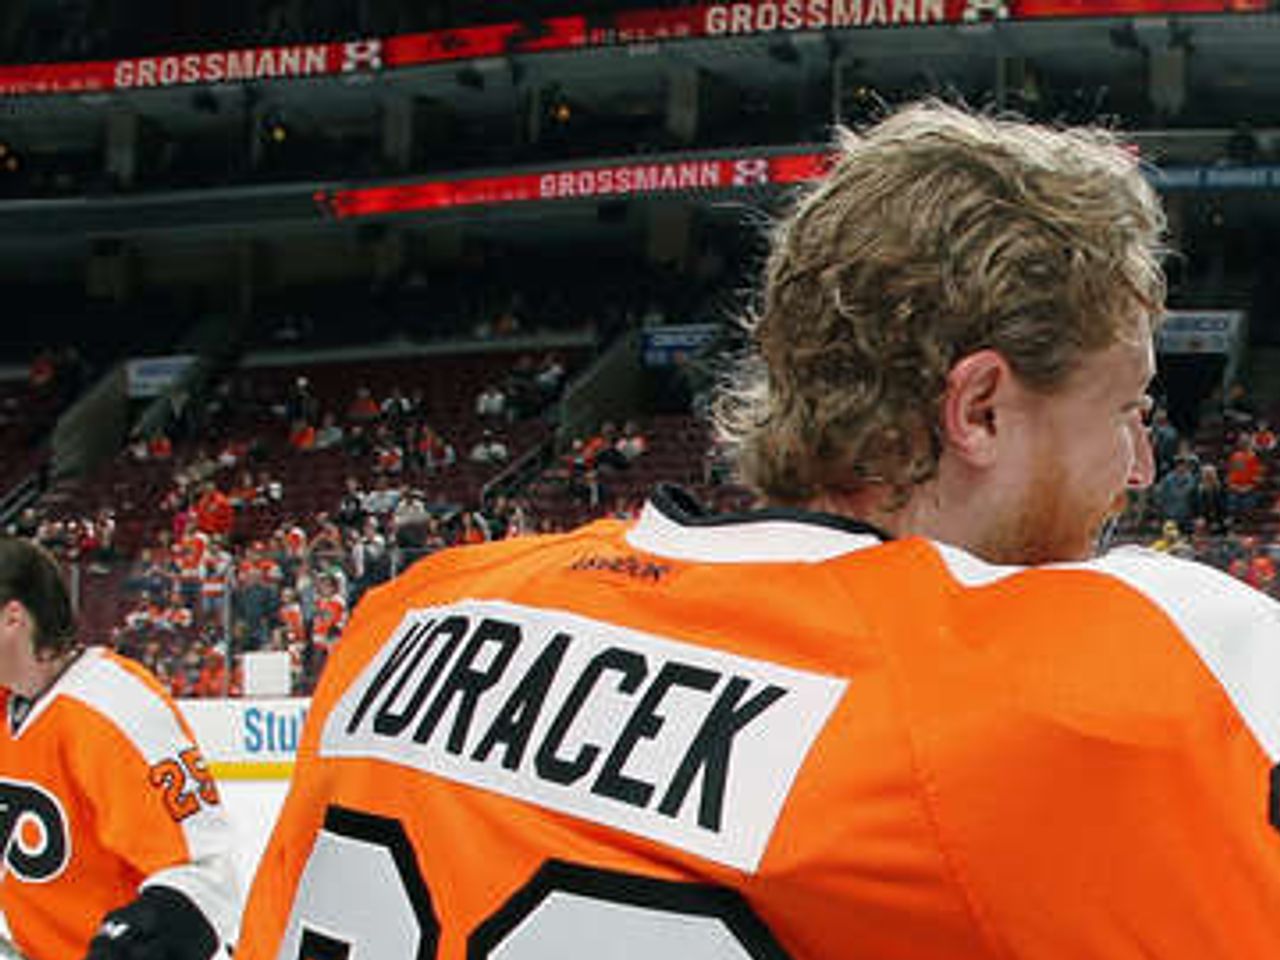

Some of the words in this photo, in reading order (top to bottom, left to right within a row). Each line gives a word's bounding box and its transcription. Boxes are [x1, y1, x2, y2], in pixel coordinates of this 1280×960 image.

[705, 0, 944, 35] GROSSMANN
[114, 46, 328, 88] GROSSMANN
[539, 161, 720, 198] GROSSMANN
[244, 707, 306, 753] Stu
[347, 614, 790, 833] VORACEK
